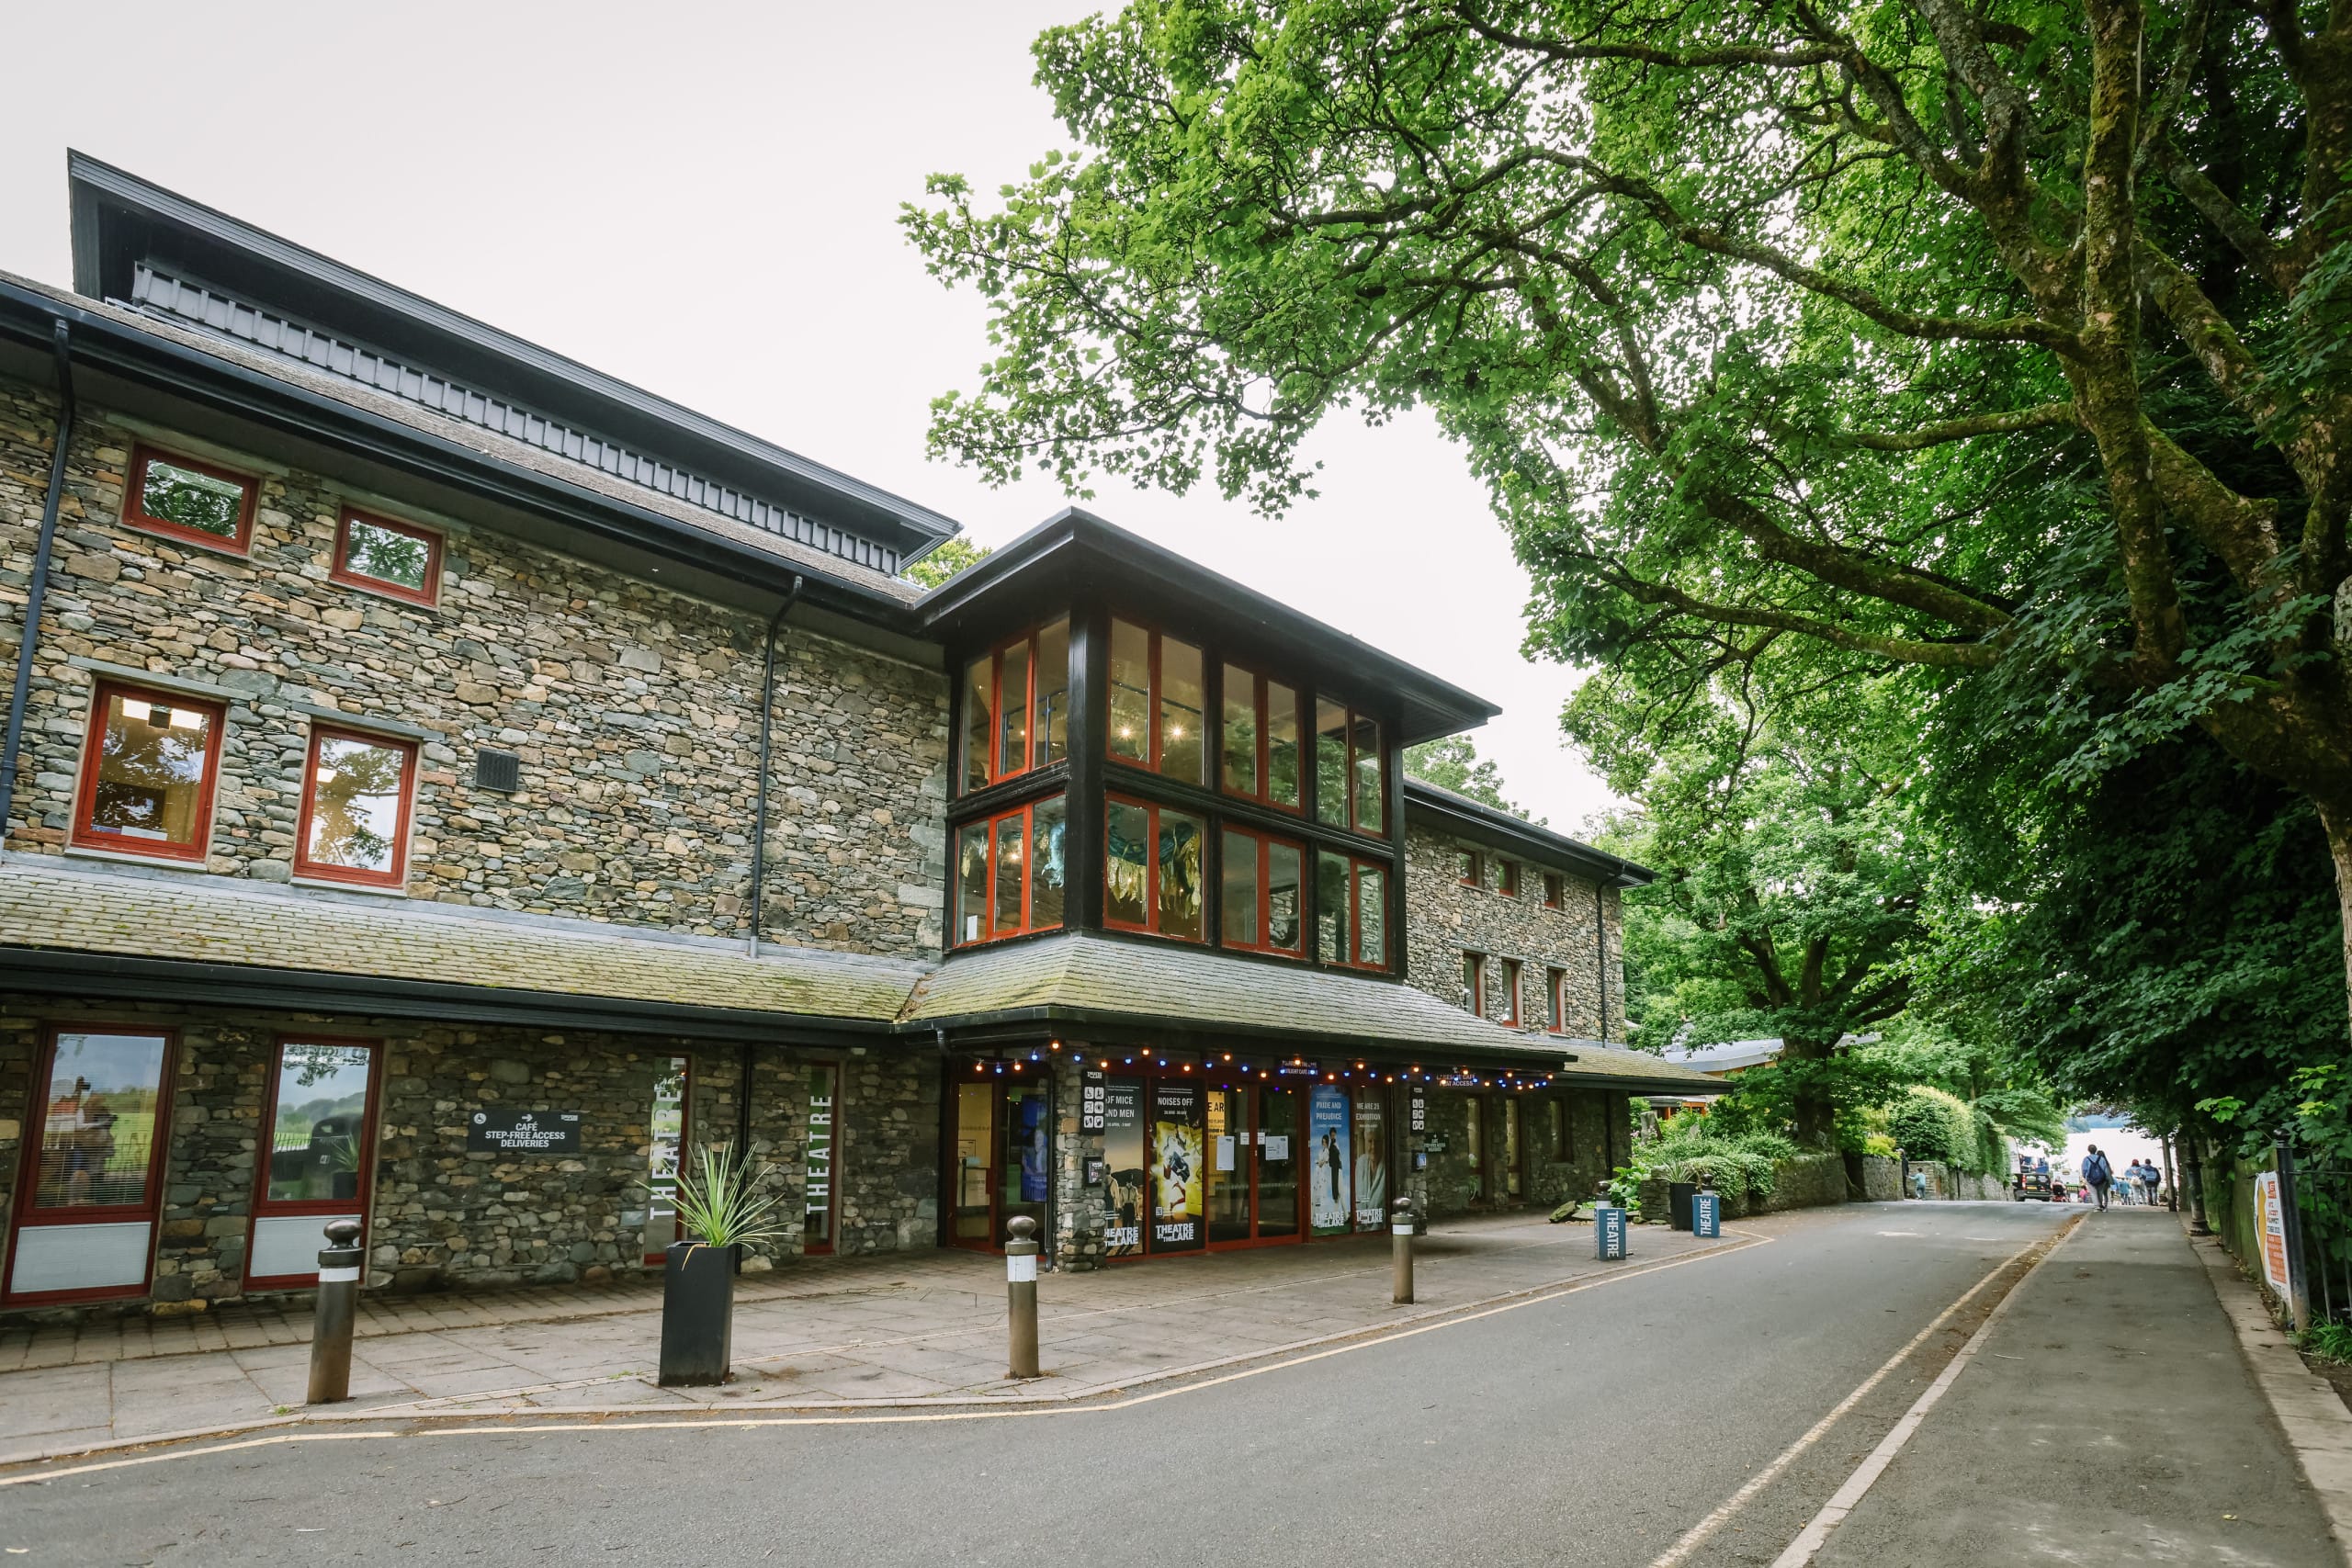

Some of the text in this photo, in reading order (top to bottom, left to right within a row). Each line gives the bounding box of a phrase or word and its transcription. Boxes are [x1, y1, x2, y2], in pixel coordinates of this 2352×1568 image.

[1115, 1095, 1134, 1105] MICE
[1158, 1097, 1194, 1107] NOISES OFF
[1119, 1109, 1135, 1118] MEN
[1316, 1112, 1342, 1121] PREJUDICE
[515, 1122, 538, 1131] CAFÉ
[485, 1131, 566, 1140] STEP-FREE ACCESS
[501, 1139, 549, 1147] DELIVERIES
[650, 1090, 683, 1221] THEATRE
[806, 1096, 831, 1214] THEATRE
[1700, 1198, 1712, 1235] THEATRE
[1103, 1226, 1138, 1237] HEATRE
[1155, 1223, 1194, 1235] THEATRE
[1607, 1211, 1619, 1258] THEATRE
[1114, 1235, 1138, 1247] LAKE
[1171, 1231, 1194, 1242] LAKE
